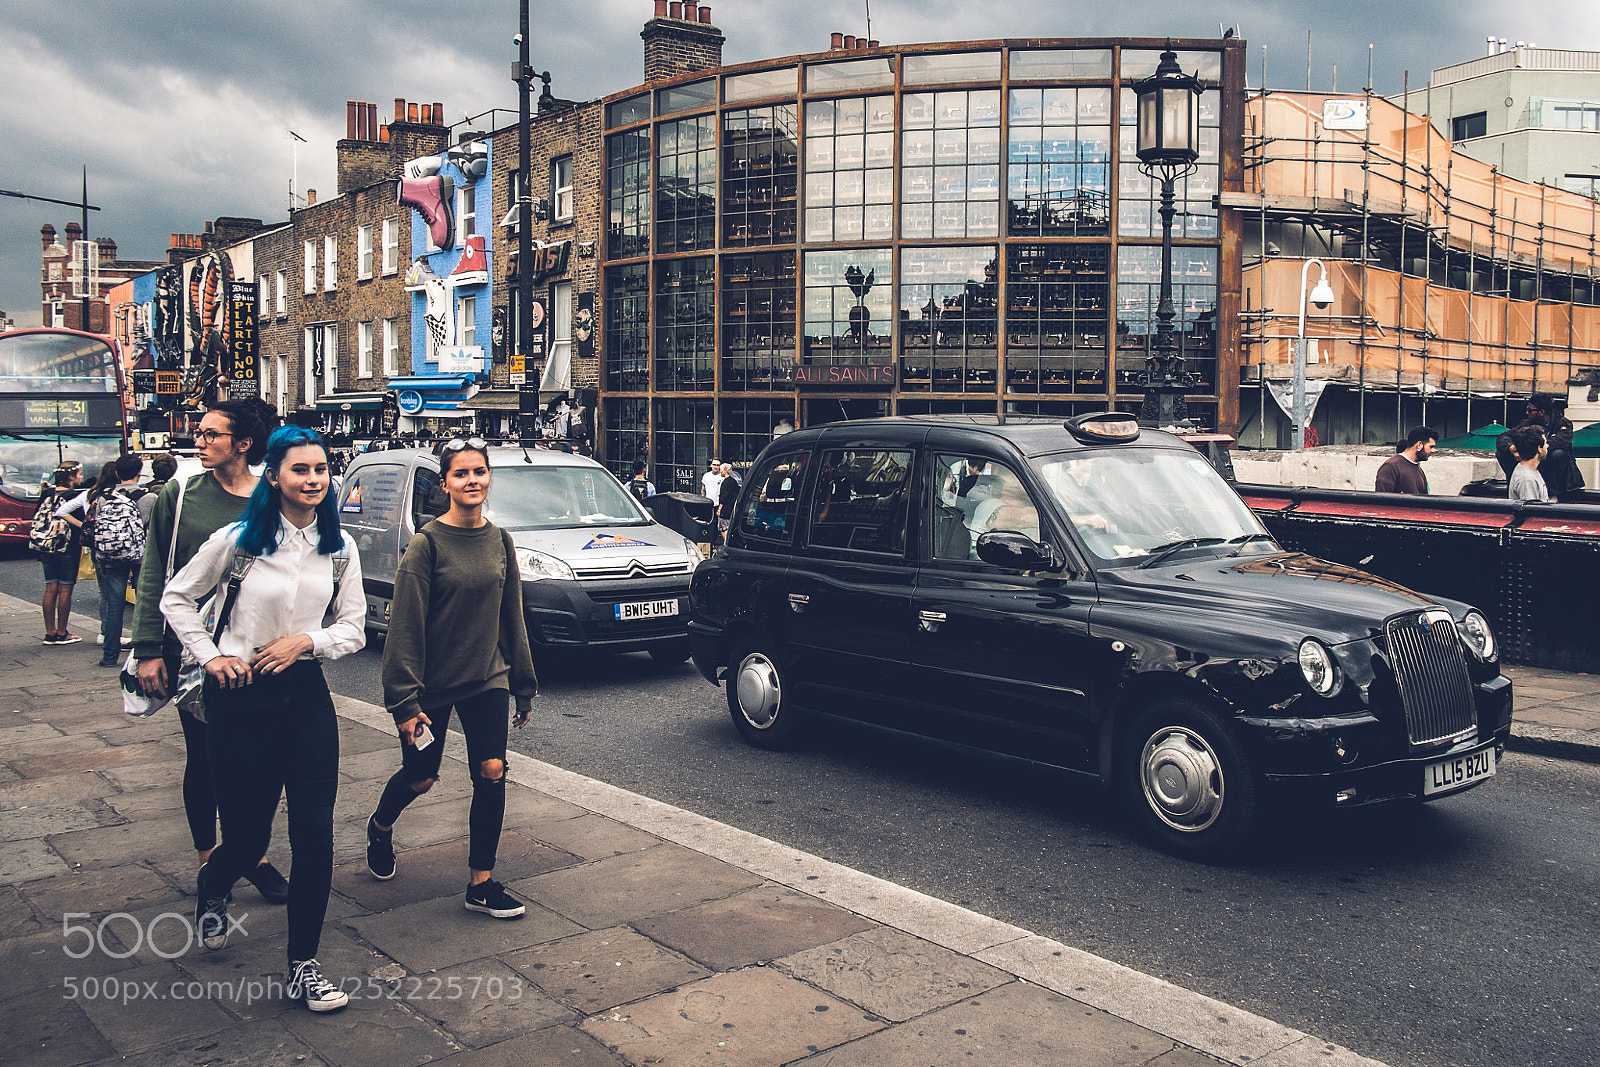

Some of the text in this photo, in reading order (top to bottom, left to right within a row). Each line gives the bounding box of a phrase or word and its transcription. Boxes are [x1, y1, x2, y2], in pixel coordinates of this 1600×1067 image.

[234, 301, 244, 379] PIERCING
[245, 302, 253, 379] TATTOO
[795, 366, 893, 383] ALL SAINTS
[72, 401, 85, 414] 31
[30, 416, 82, 425] White City
[676, 469, 694, 478] SALE
[624, 601, 674, 617] BW15 UHT
[1432, 751, 1489, 788] LL15 BZU
